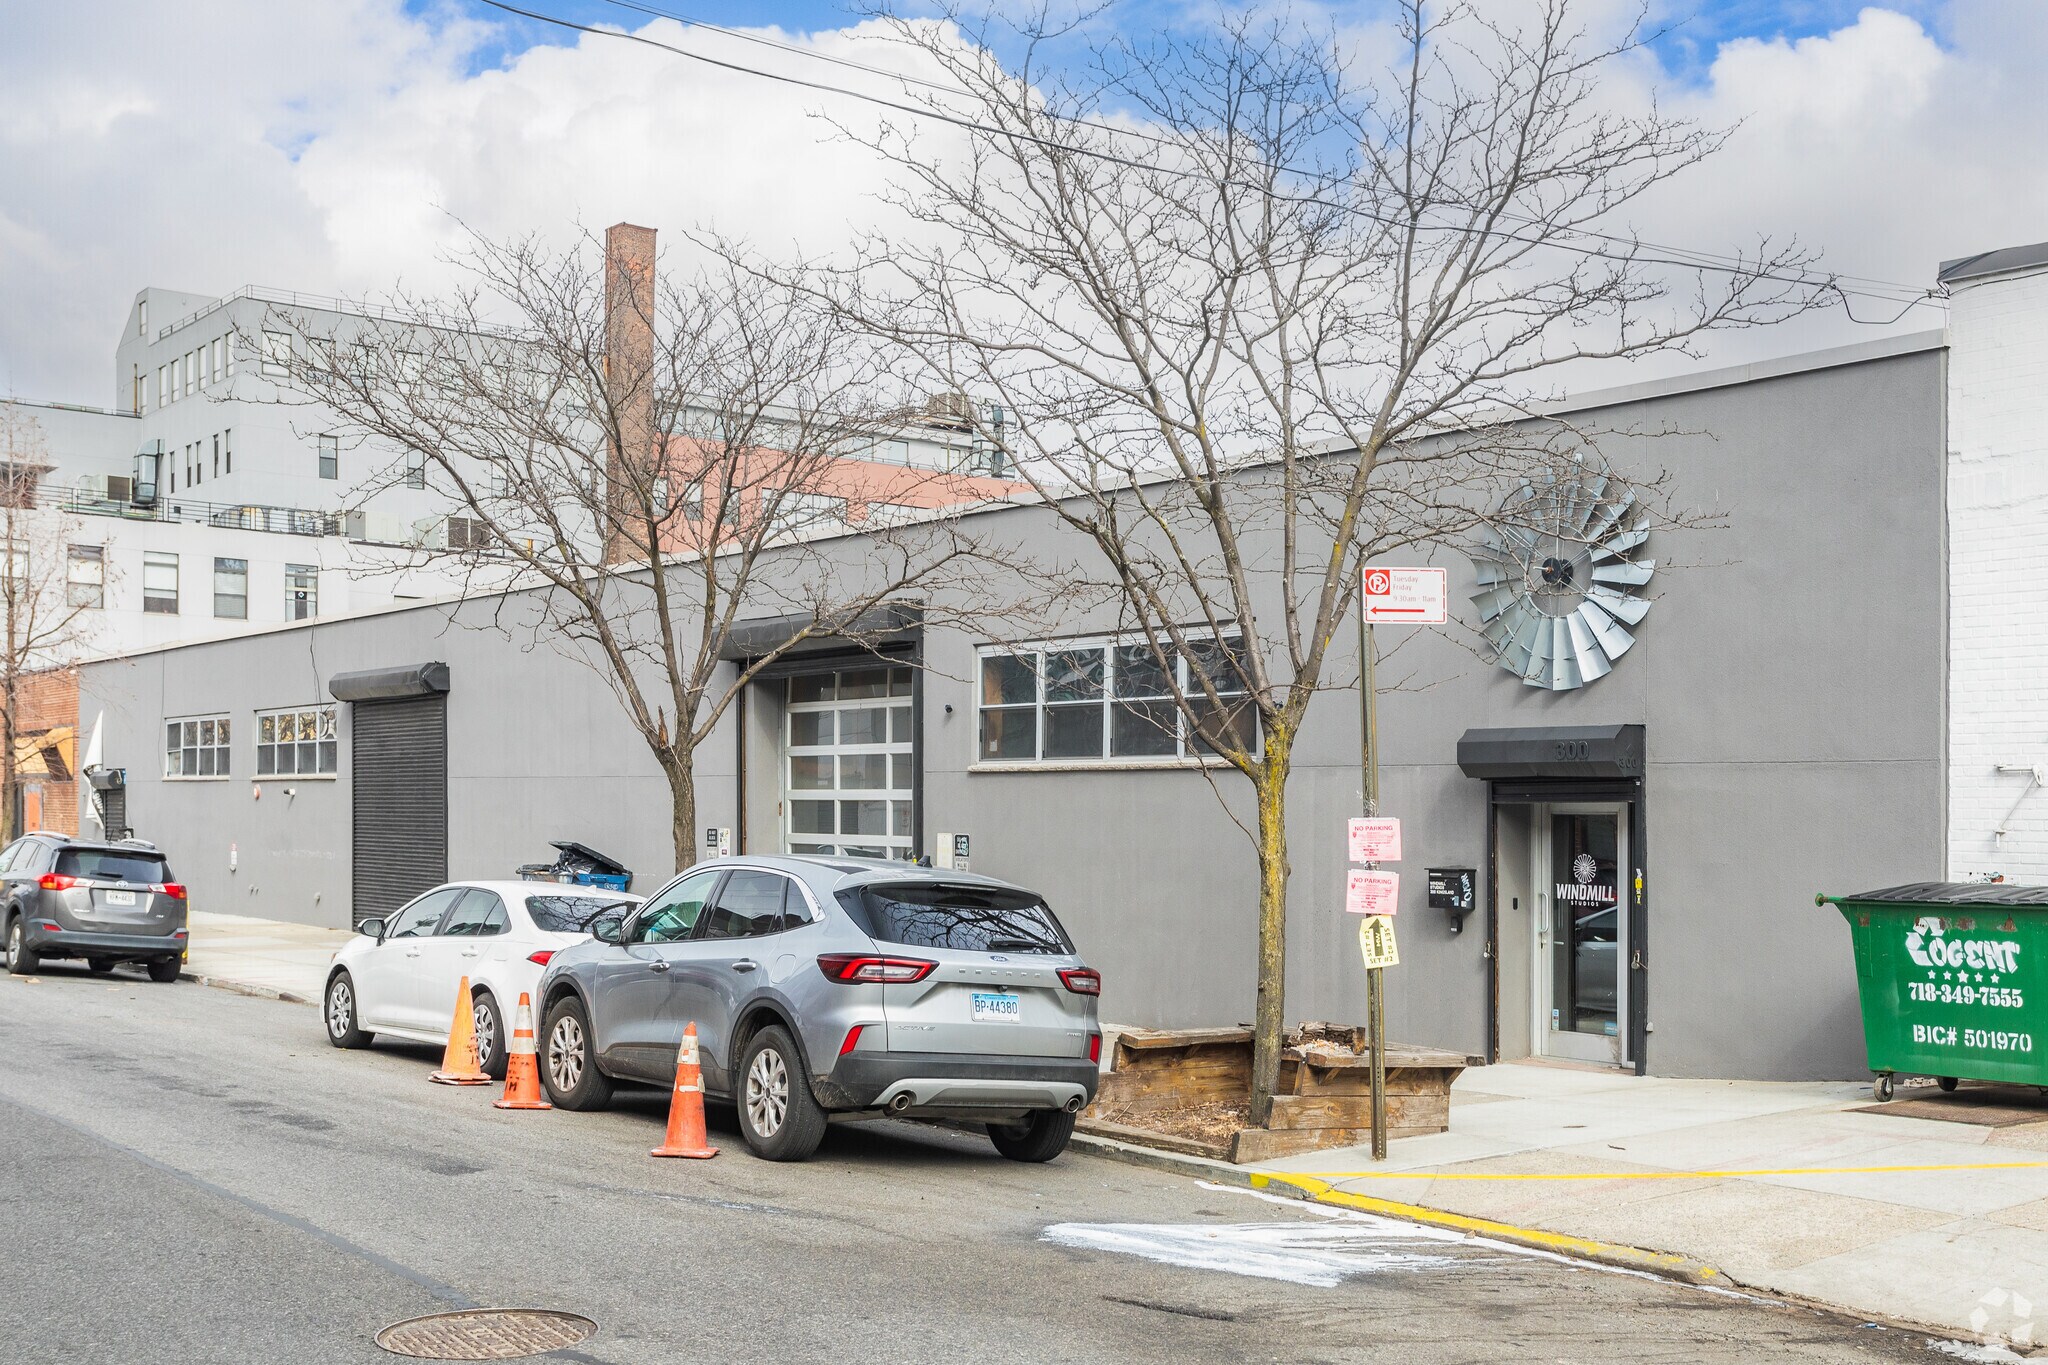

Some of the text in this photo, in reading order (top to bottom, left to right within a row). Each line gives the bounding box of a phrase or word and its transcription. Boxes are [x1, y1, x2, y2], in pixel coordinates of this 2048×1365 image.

[1393, 575, 1418, 583] Tuesday
[1555, 741, 1590, 760] 300
[1556, 883, 1615, 902] WINDMILL
[1908, 982, 2023, 1008] 718-349-7555
[1913, 1024, 2032, 1052] BIC# 501970
